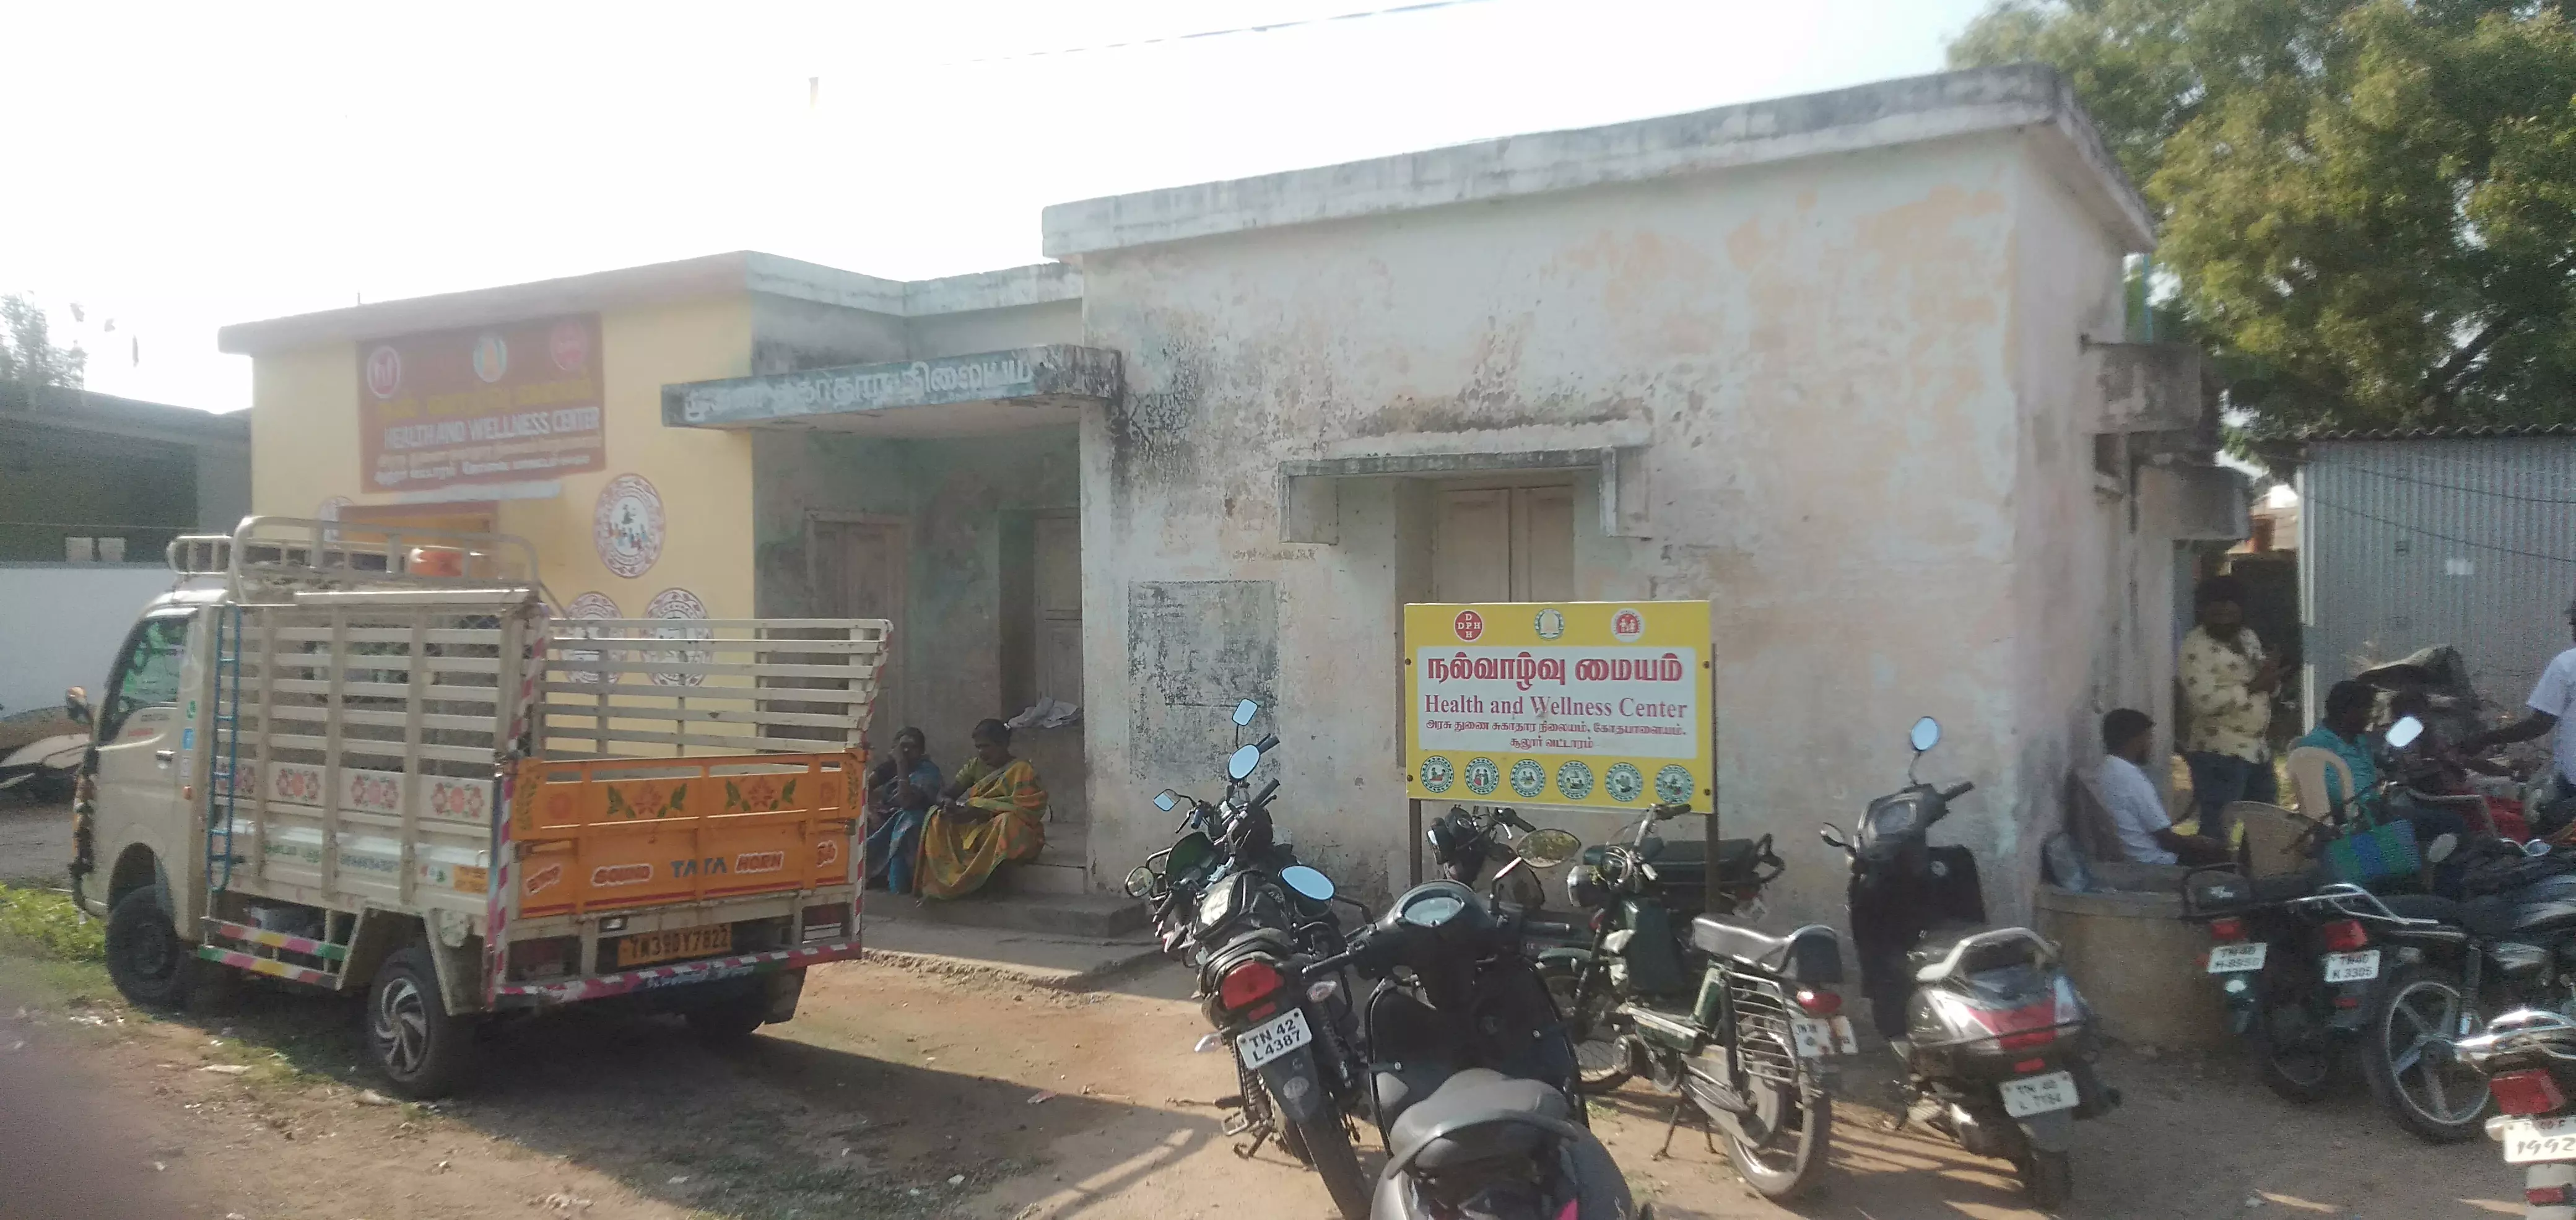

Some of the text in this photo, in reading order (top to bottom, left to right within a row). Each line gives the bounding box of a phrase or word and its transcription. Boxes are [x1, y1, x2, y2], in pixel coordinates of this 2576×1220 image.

[468, 412, 550, 441] WELLNESS
[1428, 651, 1683, 691] நல்வாழ்வு மையம்
[1425, 694, 1688, 718] Health and Wellness Center
[1426, 720, 1452, 730] அரசு
[1454, 721, 1489, 732] துணை
[1492, 721, 1536, 732] சுகாதார
[1546, 736, 1593, 749] வட்டாரம்
[671, 857, 728, 878] TATA
[1249, 1019, 1296, 1048] TN 42
[2517, 1137, 2576, 1156] 1992
